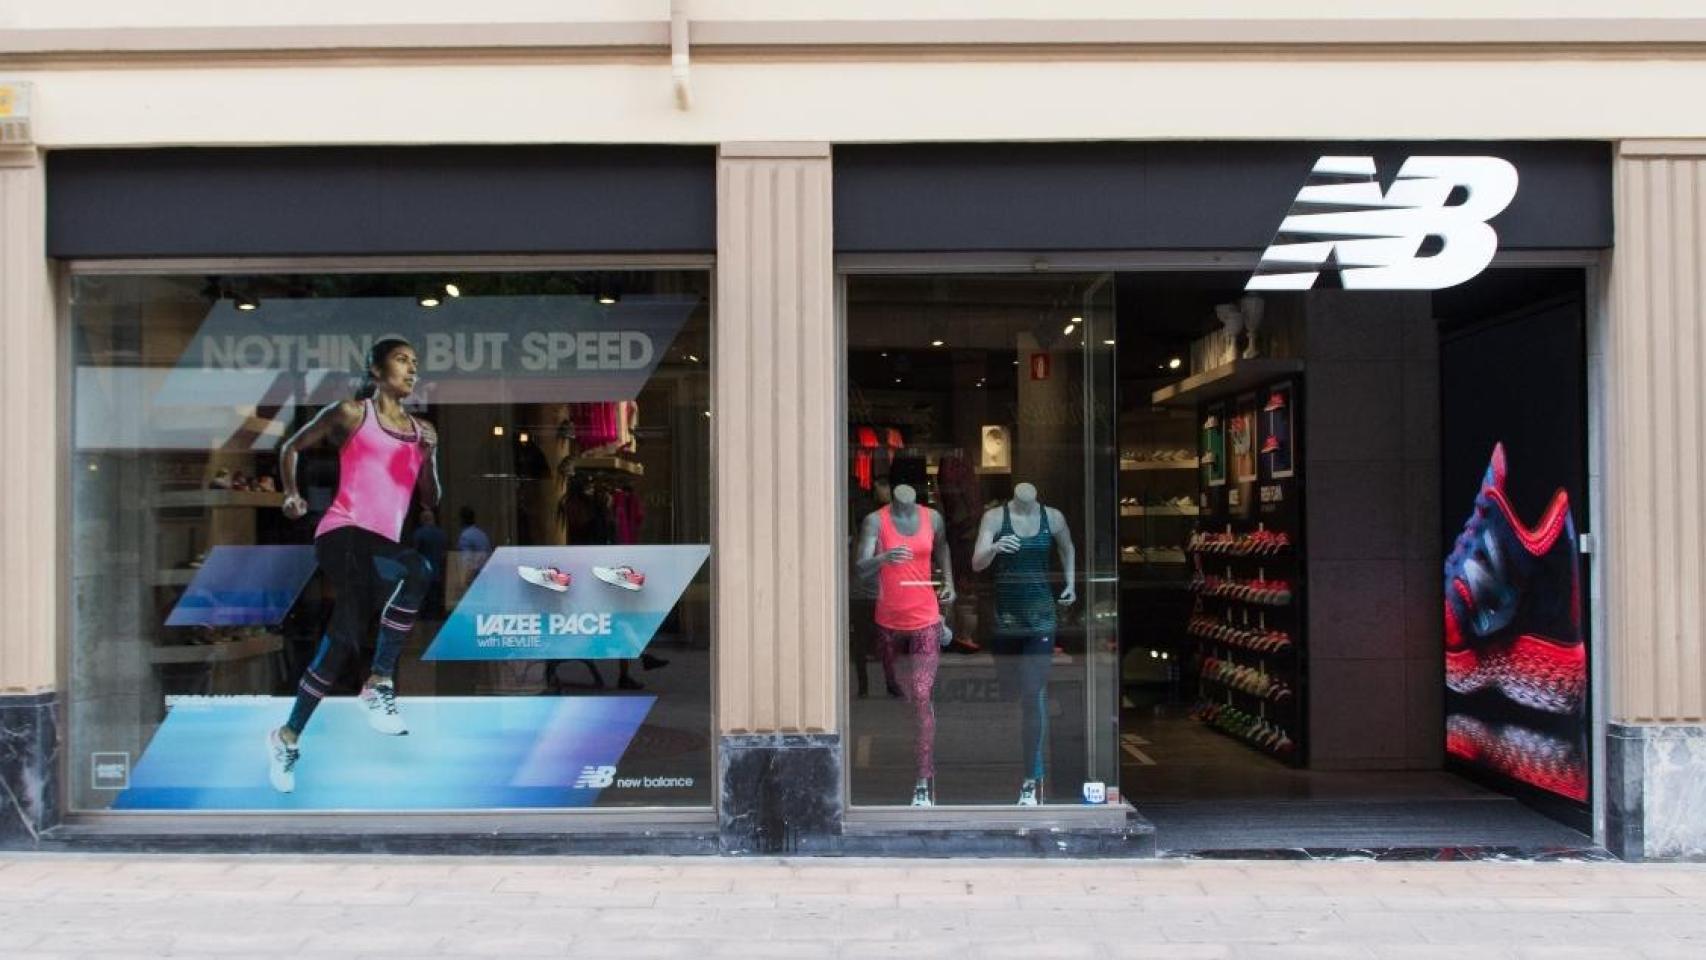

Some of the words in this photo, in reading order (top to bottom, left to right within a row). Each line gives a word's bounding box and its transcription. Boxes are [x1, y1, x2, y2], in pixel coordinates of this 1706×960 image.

[1244, 155, 1519, 291] NB
[203, 334, 413, 371] NOTHIN
[426, 332, 508, 371] BUT
[521, 331, 654, 370] SPEED
[476, 613, 542, 635] VAZEE
[549, 613, 612, 635] PACE
[477, 636, 500, 648] with
[573, 765, 617, 788] NB
[617, 778, 640, 788] new
[644, 776, 694, 787] balance
